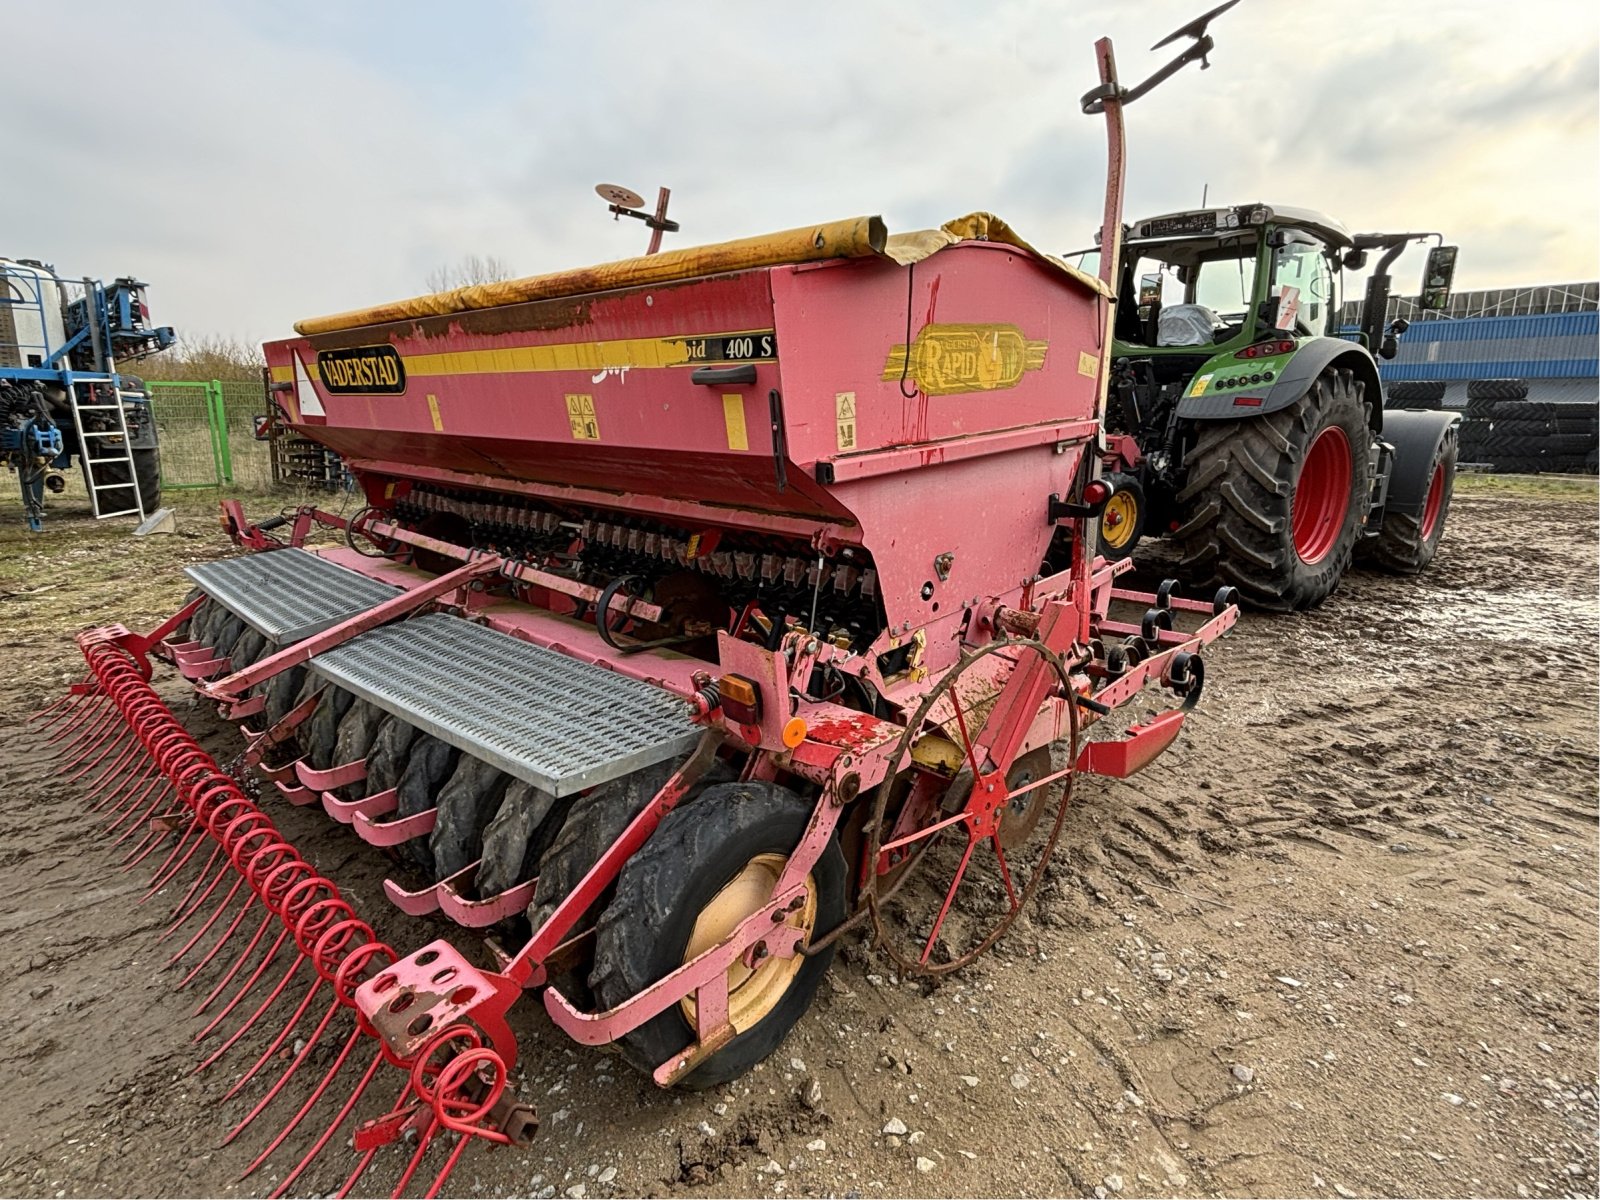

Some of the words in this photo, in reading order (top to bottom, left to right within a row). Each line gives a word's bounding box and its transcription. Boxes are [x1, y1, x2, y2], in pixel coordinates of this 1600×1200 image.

[726, 338, 753, 358] 400
[761, 336, 772, 357] S
[321, 353, 399, 386] VÄDERSTAD
